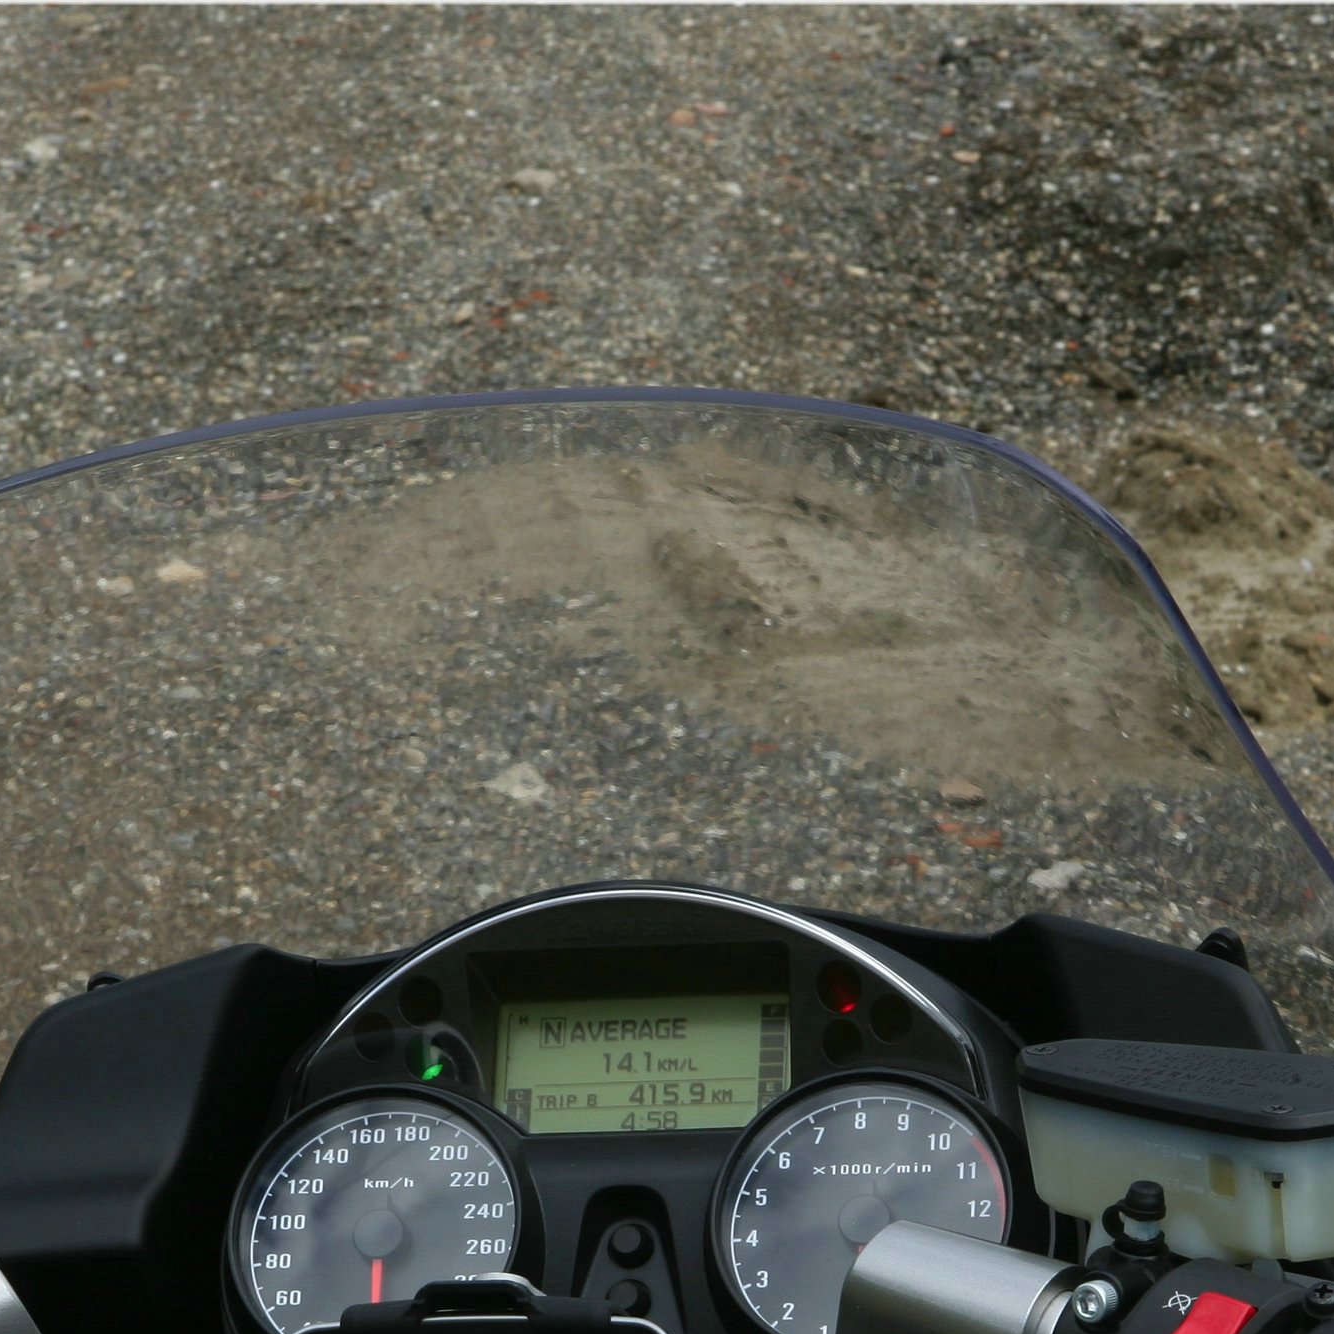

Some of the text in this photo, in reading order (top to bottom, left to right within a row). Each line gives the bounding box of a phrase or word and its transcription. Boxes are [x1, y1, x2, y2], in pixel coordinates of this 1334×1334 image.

[518, 1014, 529, 1025] H
[543, 1017, 687, 1046] N AVERAGE
[602, 1051, 698, 1074] 14.1 KM/L
[536, 1082, 733, 1109] TRIP B 415.9 KM
[620, 1110, 678, 1131] 4:58
[854, 1112, 866, 1129] 8
[898, 1114, 910, 1131] 9
[349, 1129, 386, 1144] 160
[394, 1126, 430, 1141] 180
[813, 1127, 825, 1144] 7
[927, 1133, 951, 1150] 10
[313, 1149, 349, 1164] 140
[429, 1145, 468, 1161] 200
[779, 1152, 791, 1169] 6
[957, 1162, 977, 1179] 11
[288, 1179, 324, 1194] 120
[364, 1177, 414, 1189] km/h
[449, 1172, 490, 1187] 220
[755, 1188, 767, 1205] 5
[463, 1204, 504, 1219] 240
[968, 1200, 991, 1217] 12
[269, 1215, 306, 1230] 100
[746, 1229, 758, 1246] 4
[466, 1239, 506, 1255] 260
[265, 1253, 291, 1269] 80
[756, 1270, 768, 1288] 3
[275, 1290, 301, 1306] 60
[782, 1303, 795, 1320] 2
